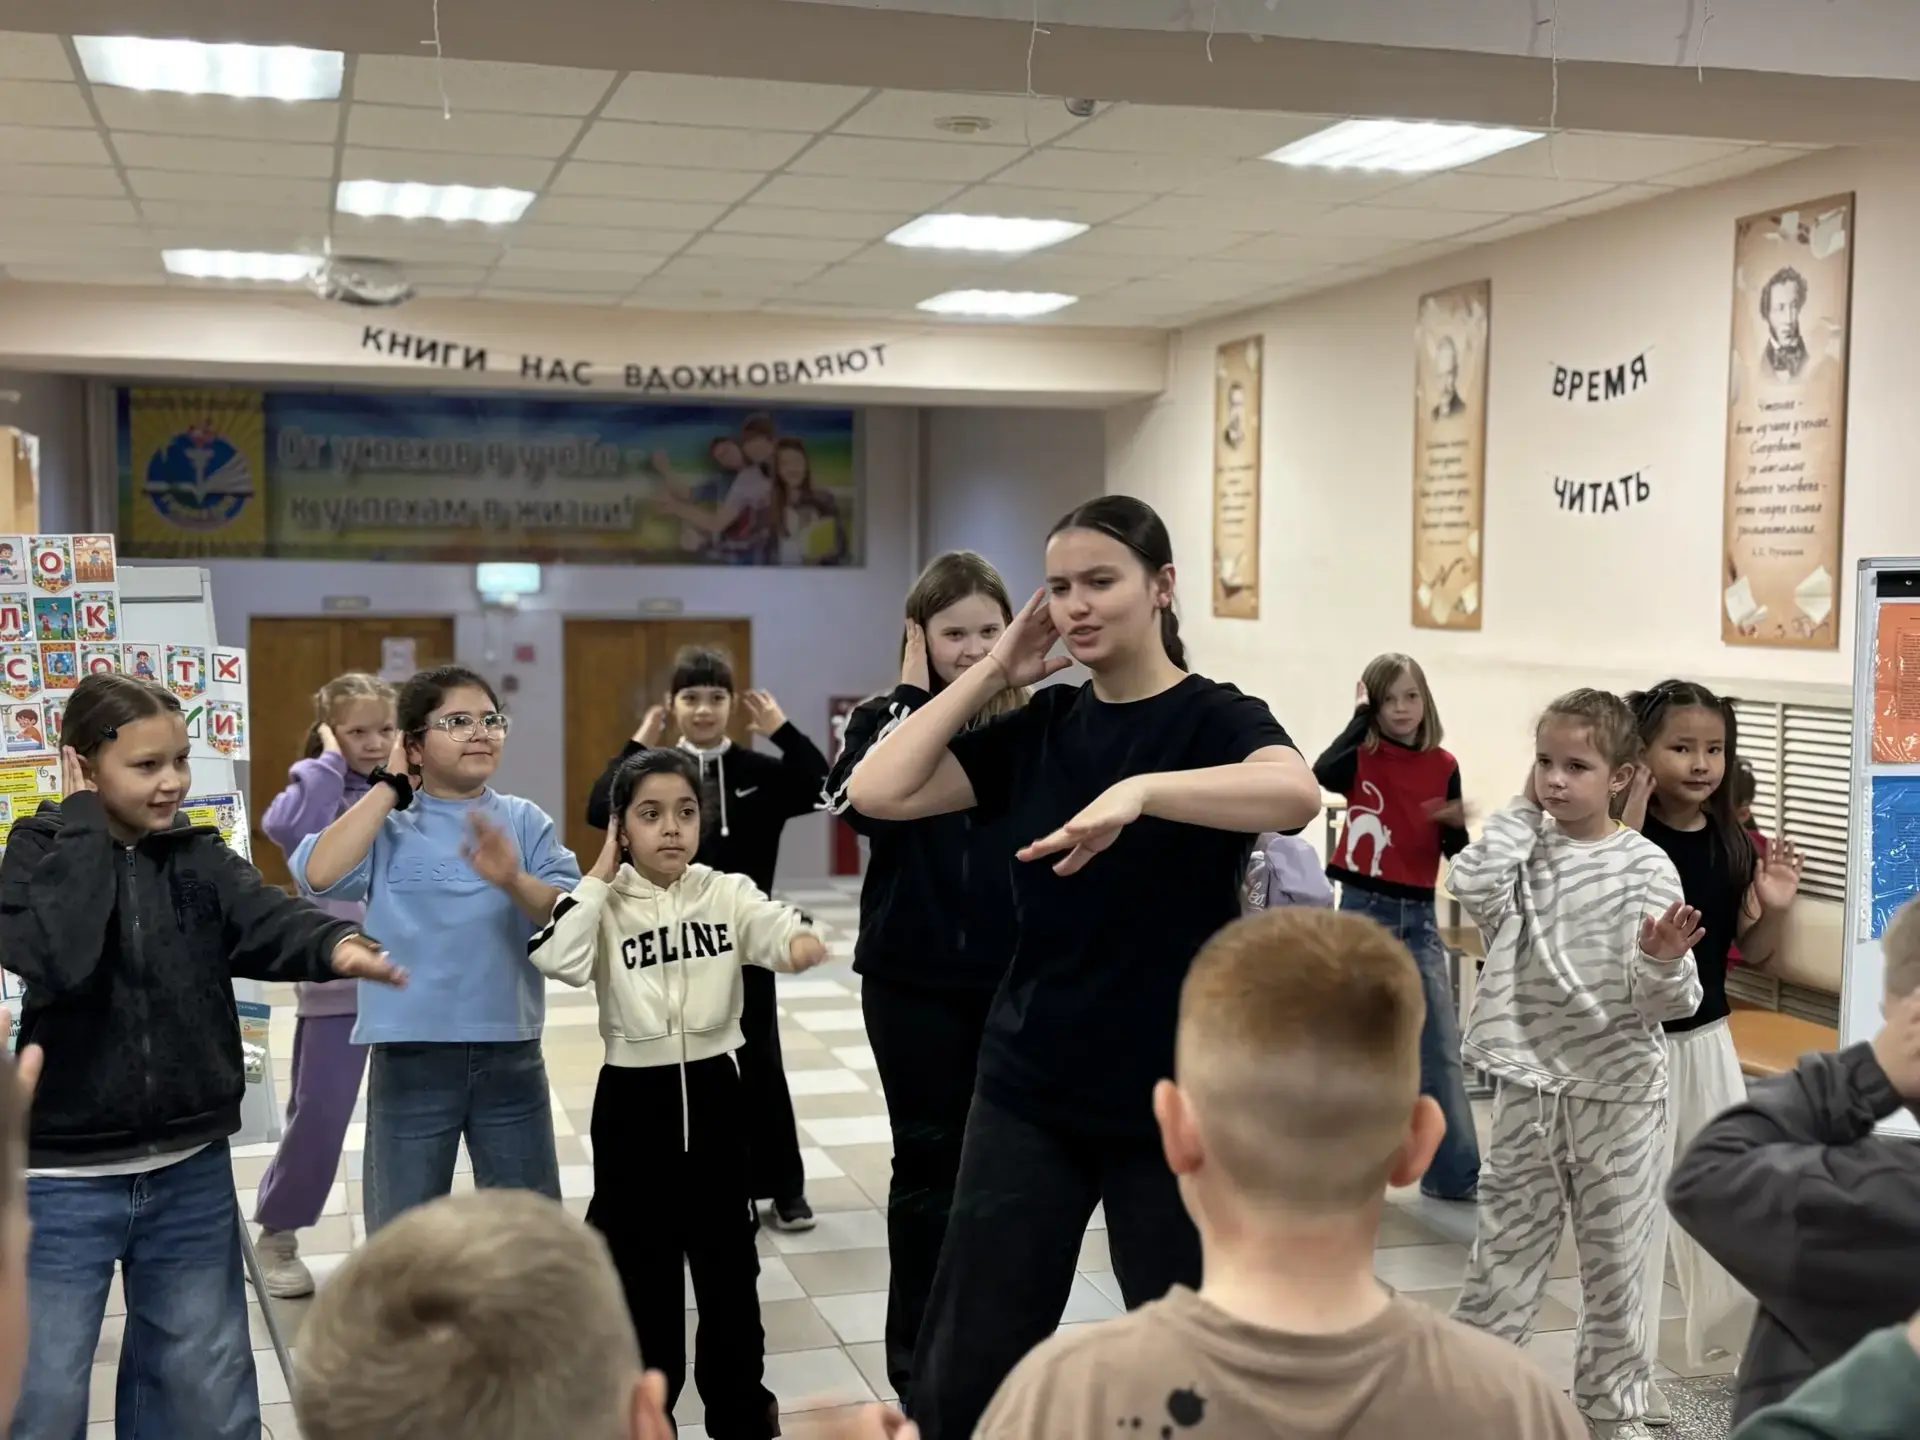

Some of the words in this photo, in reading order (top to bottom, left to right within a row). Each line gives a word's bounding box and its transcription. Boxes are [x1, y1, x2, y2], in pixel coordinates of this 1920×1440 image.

[362, 325, 487, 373] КНИГИ
[520, 354, 592, 386] НАС
[625, 343, 886, 394] ВДОХНОВЛЯЮТ
[1552, 353, 1648, 402] ВРЕМЯ
[1554, 472, 1650, 513] ЧИТАТЬ
[39, 551, 62, 574] О
[0, 607, 20, 630] Л
[86, 605, 106, 628] К
[7, 658, 28, 681] С
[177, 660, 195, 682] Т
[215, 714, 234, 735] И
[622, 921, 733, 970] CELINE
